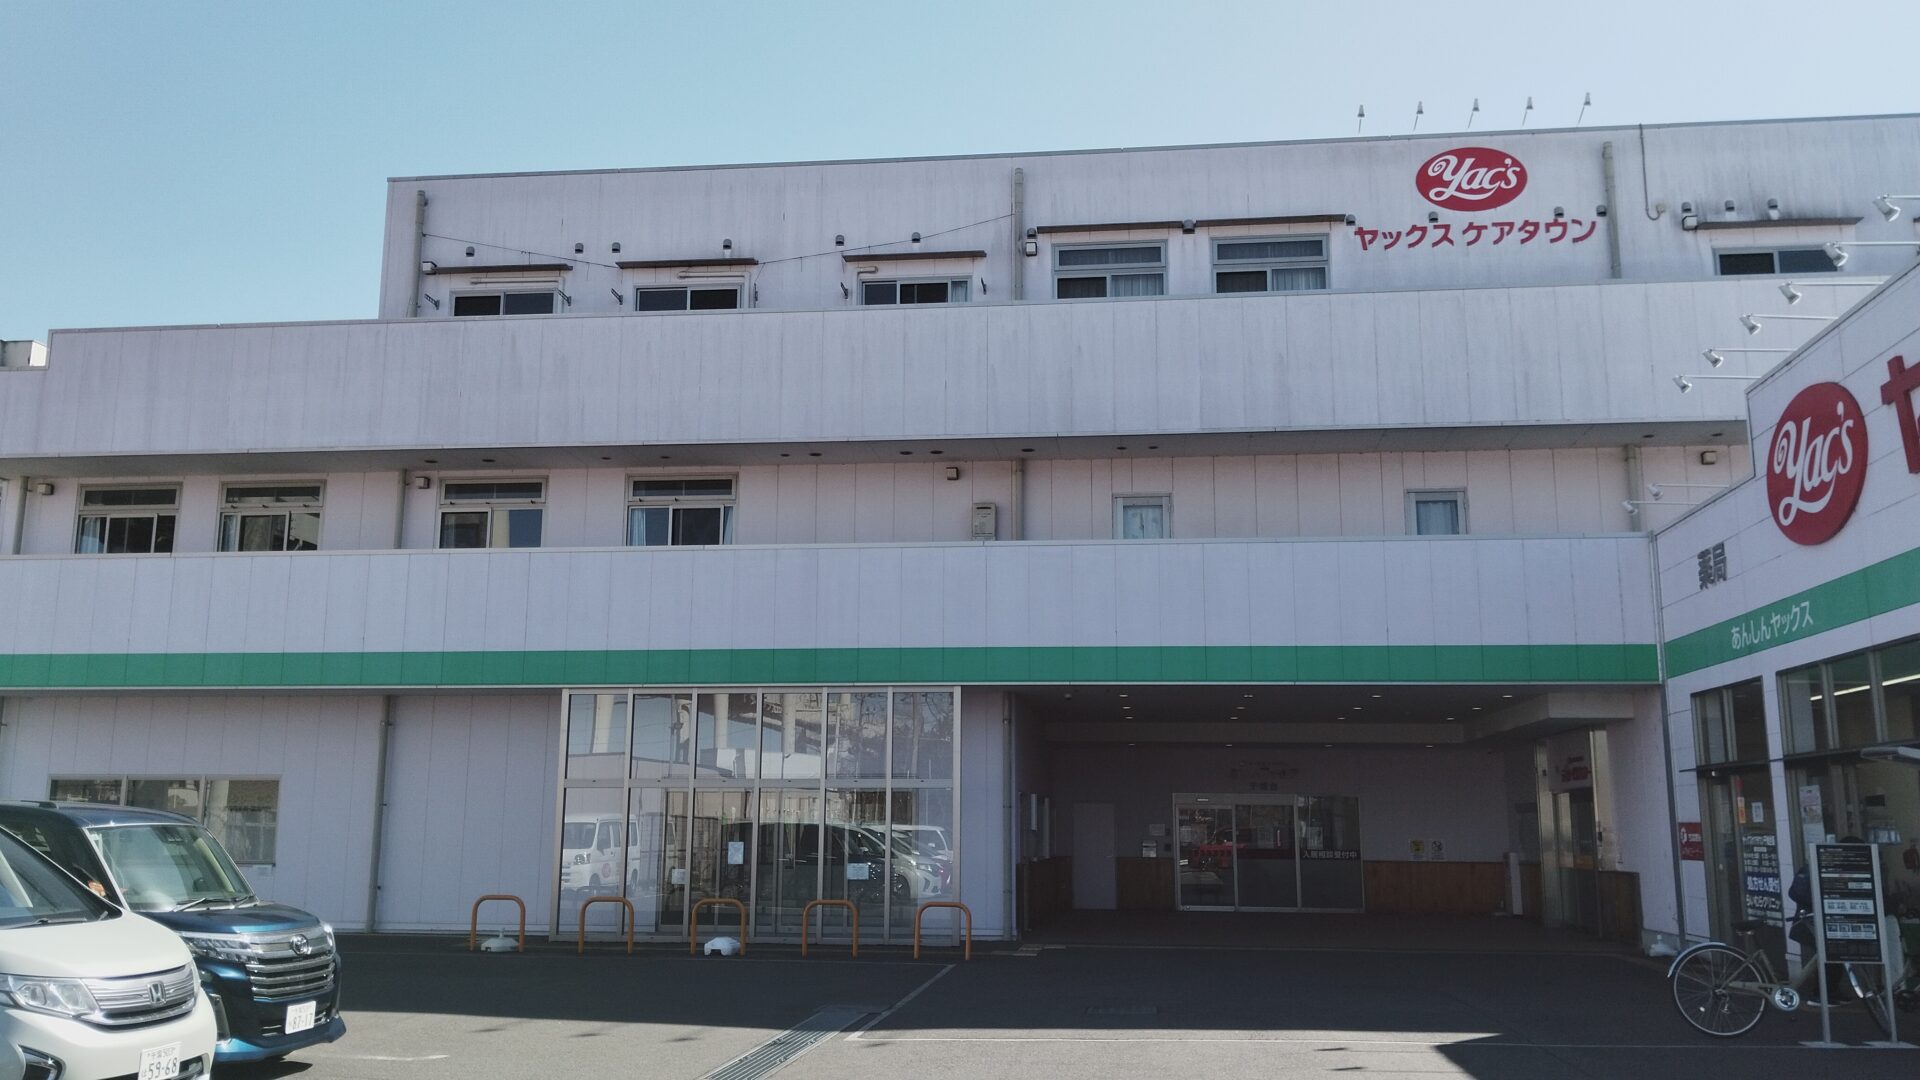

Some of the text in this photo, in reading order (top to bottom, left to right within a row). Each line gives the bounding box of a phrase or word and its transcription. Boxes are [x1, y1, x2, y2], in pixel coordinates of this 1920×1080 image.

[1697, 542, 1728, 591] 薬局
[1731, 600, 1814, 650] あんしんヤックス
